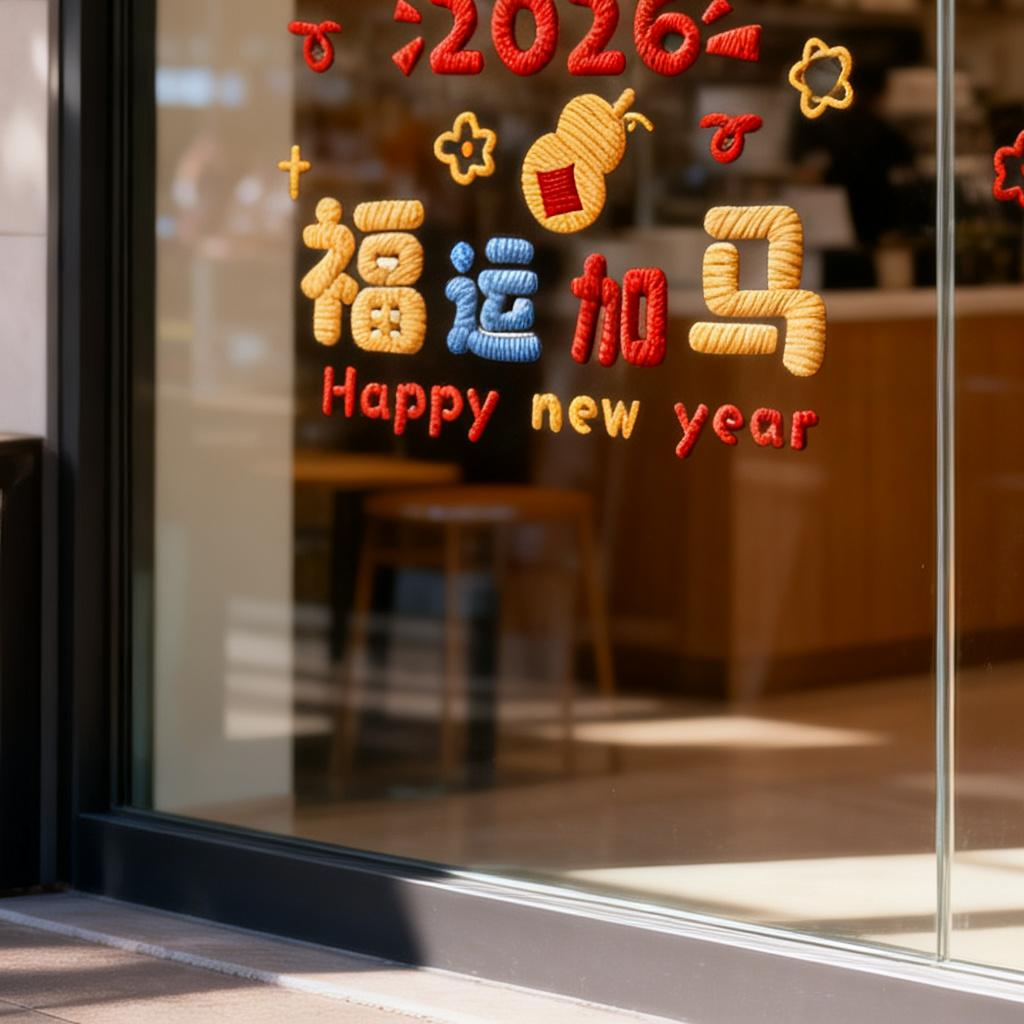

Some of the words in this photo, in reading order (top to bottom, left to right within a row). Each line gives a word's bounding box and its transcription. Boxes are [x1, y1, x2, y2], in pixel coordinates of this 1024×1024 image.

[322, 366, 499, 442] Happy
[531, 392, 640, 438] new
[674, 402, 818, 458] year
